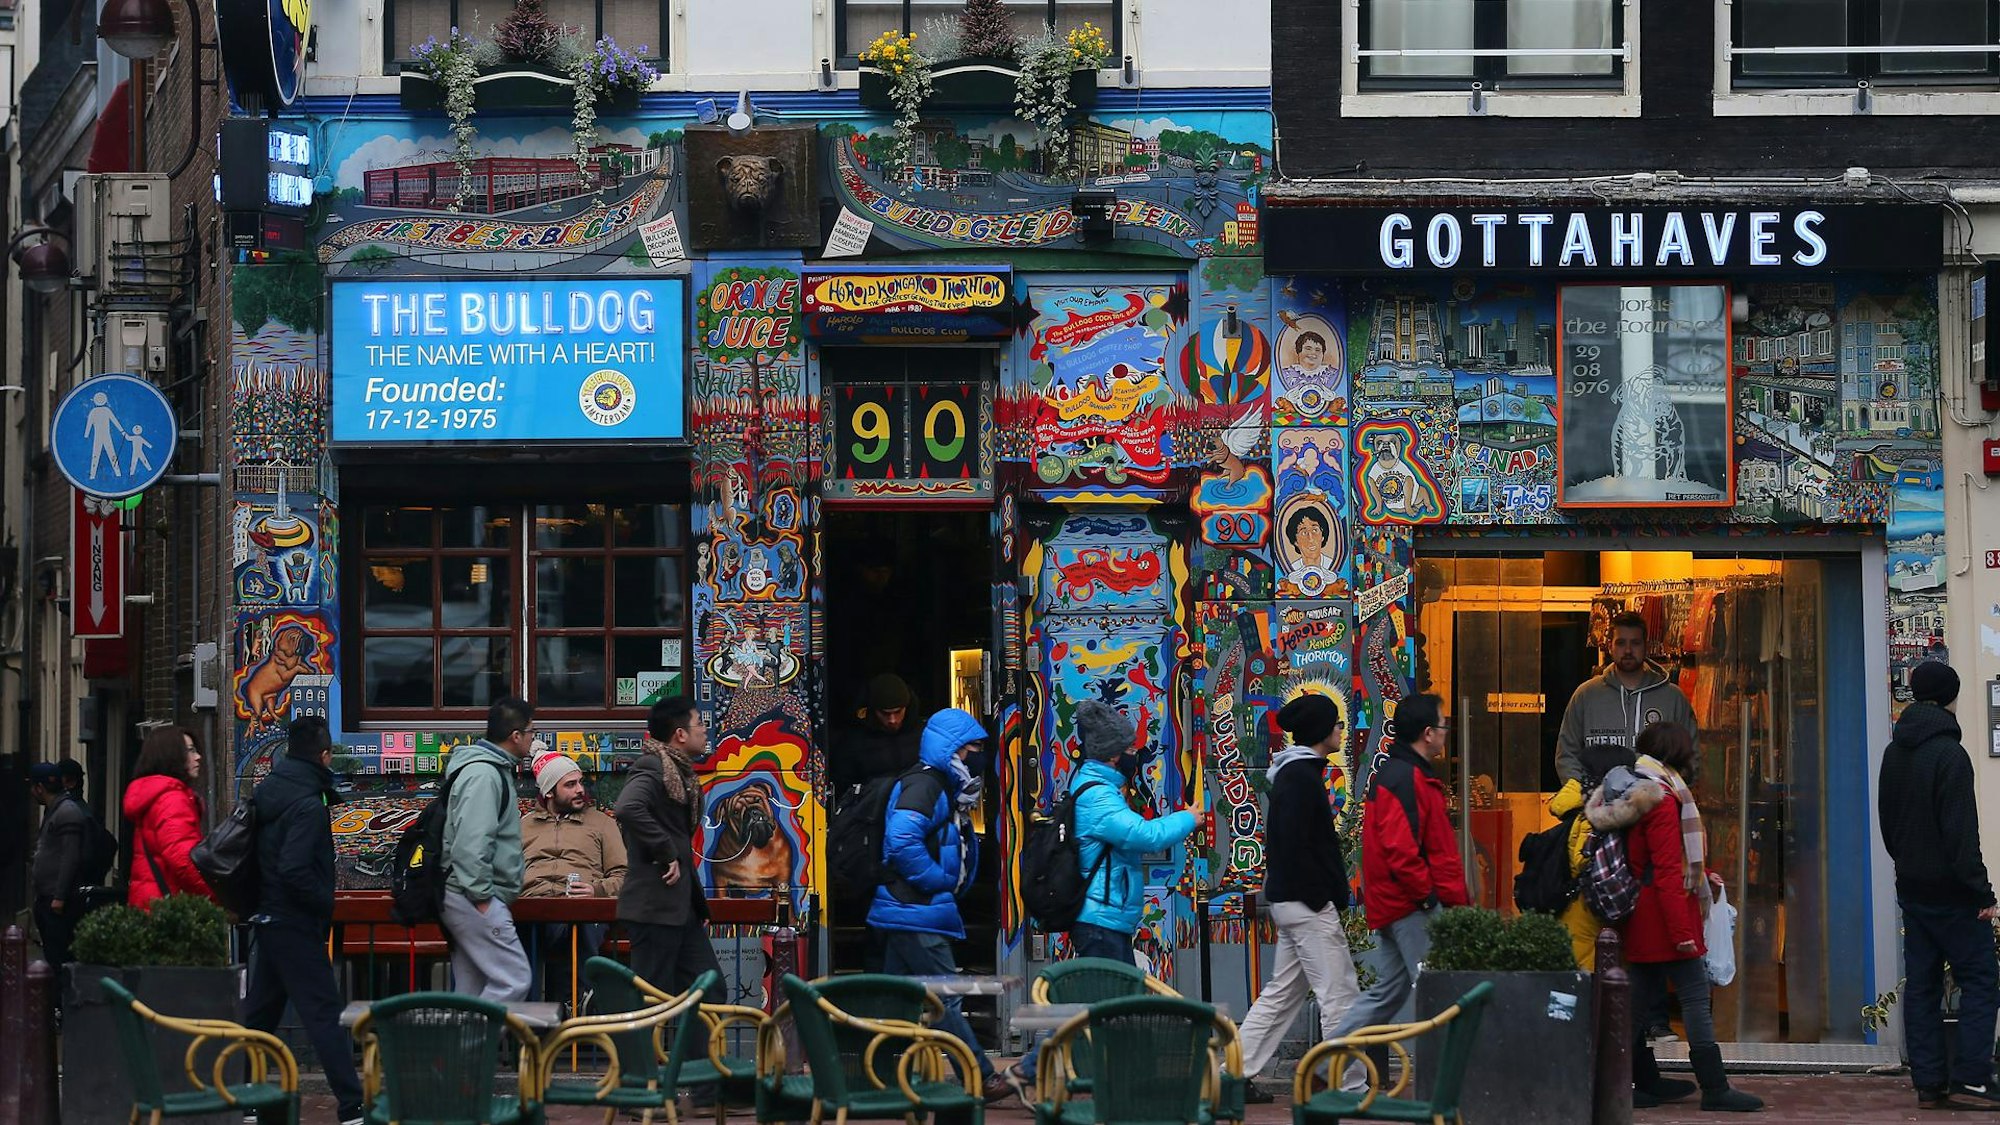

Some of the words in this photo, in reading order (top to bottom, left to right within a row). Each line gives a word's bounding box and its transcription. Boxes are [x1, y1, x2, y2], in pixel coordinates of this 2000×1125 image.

[367, 222, 446, 241] FIRST
[450, 224, 521, 247] BEST
[517, 232, 535, 247] &
[536, 194, 648, 247] BIGGEST
[870, 195, 992, 240] BULLDOG
[644, 225, 657, 233] STOP
[645, 226, 677, 242] BULLDOGS
[1379, 211, 1827, 268] GOTTAHAVES
[647, 236, 679, 250] DECORATE
[711, 277, 799, 313] ORANGE
[828, 278, 876, 306] HAROLD
[1069, 296, 1083, 305] OUR
[363, 291, 448, 337] THE
[459, 288, 656, 336] BULLDOG
[707, 315, 793, 349] JUICE
[890, 326, 936, 335] BULLDOG
[1052, 329, 1063, 338] The
[1063, 316, 1093, 332] BULLDOG
[1564, 317, 1608, 335] the
[365, 344, 411, 367] THE
[417, 343, 483, 366] NAME
[488, 343, 546, 365] WITH
[551, 343, 569, 365] A
[573, 342, 656, 364] HEART!
[1575, 345, 1601, 362] 29
[1573, 362, 1601, 377] 08
[364, 375, 506, 404] Founded:
[1563, 380, 1610, 397] 1976
[365, 408, 498, 430] 17-12-1975
[583, 403, 632, 424] AMSTERDAM
[1036, 424, 1060, 434] BULLDOG
[1067, 457, 1087, 467] RENT
[1094, 446, 1112, 458] BIKE
[1465, 443, 1553, 476] CANADA
[1216, 513, 1256, 542] 90
[92, 535, 103, 592] INGANG
[1327, 606, 1341, 617] ART
[1281, 622, 1326, 654] HAROLD
[1294, 650, 1348, 668] THORNTON
[641, 680, 677, 688] COFFEE
[647, 688, 672, 696] SHOP
[1213, 692, 1263, 872] BULLDOG
